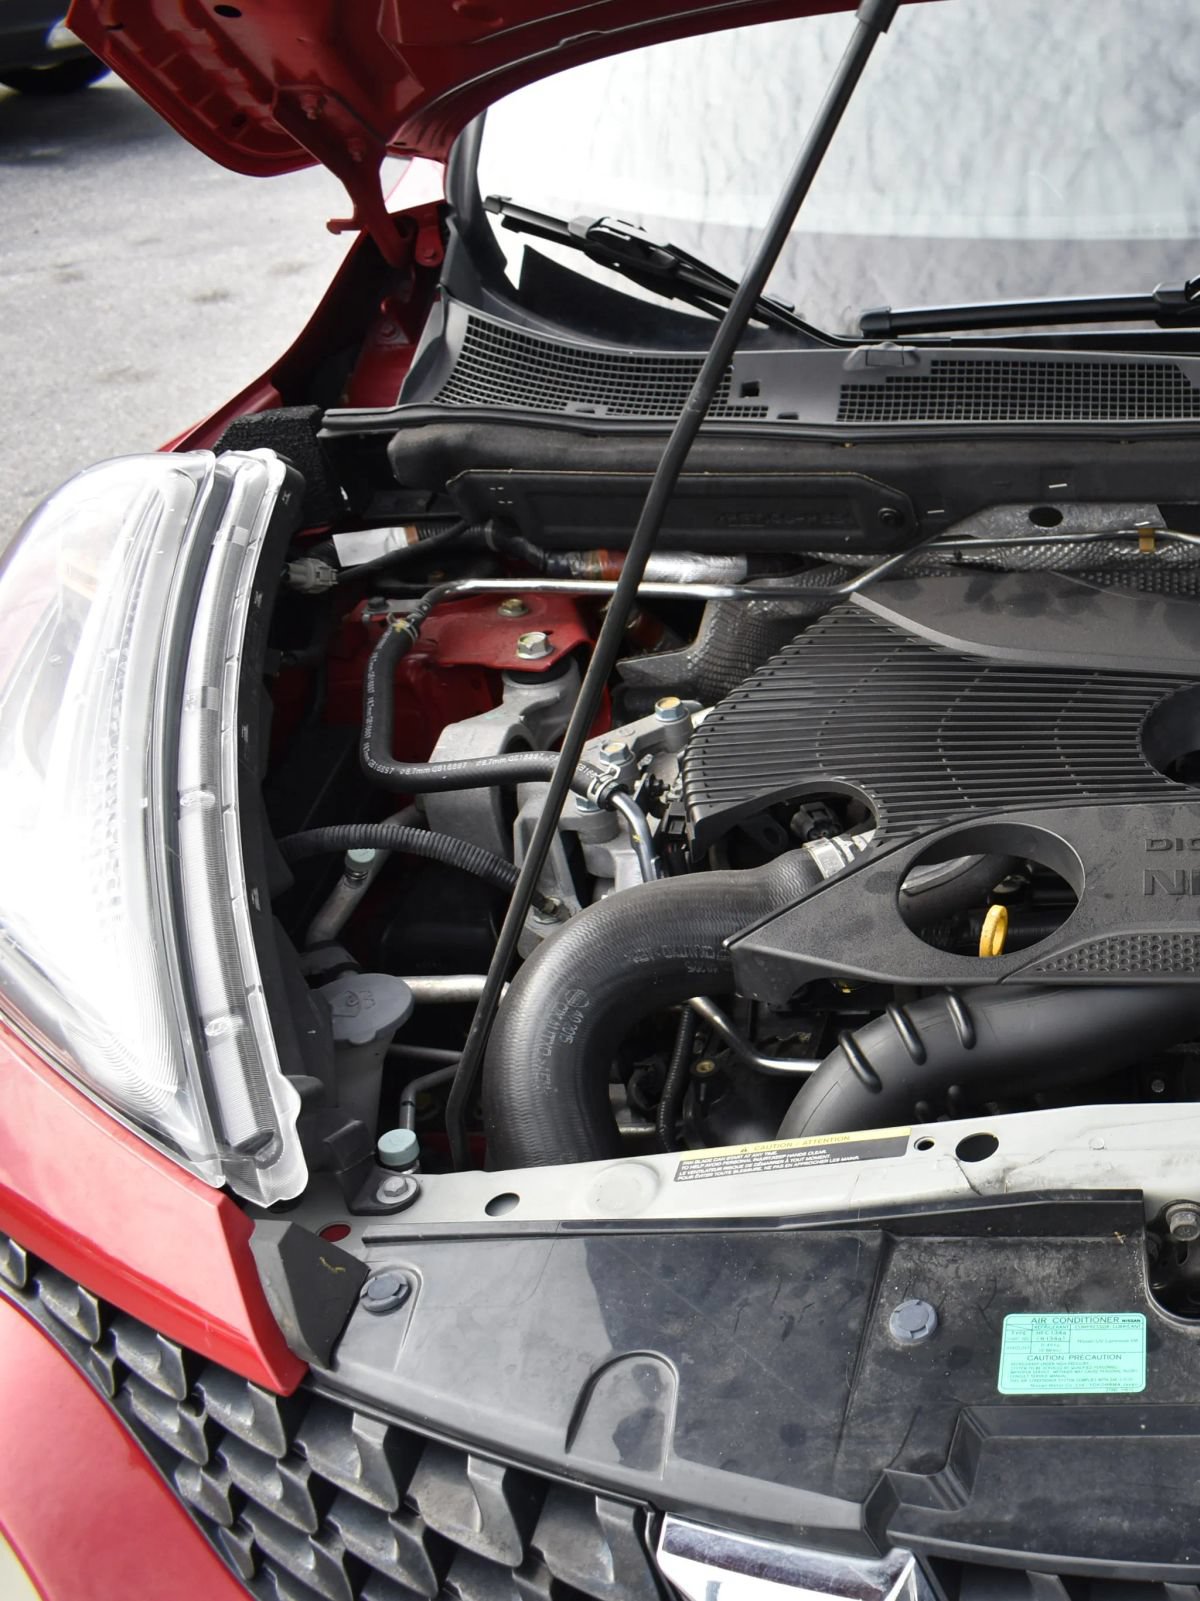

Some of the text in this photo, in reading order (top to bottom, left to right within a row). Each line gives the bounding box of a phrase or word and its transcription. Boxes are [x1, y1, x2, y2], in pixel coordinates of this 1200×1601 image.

[754, 1142, 792, 1151] CAUTION
[802, 1135, 850, 1146] ATTENTION
[1052, 1316, 1120, 1324] CONDITIONER
